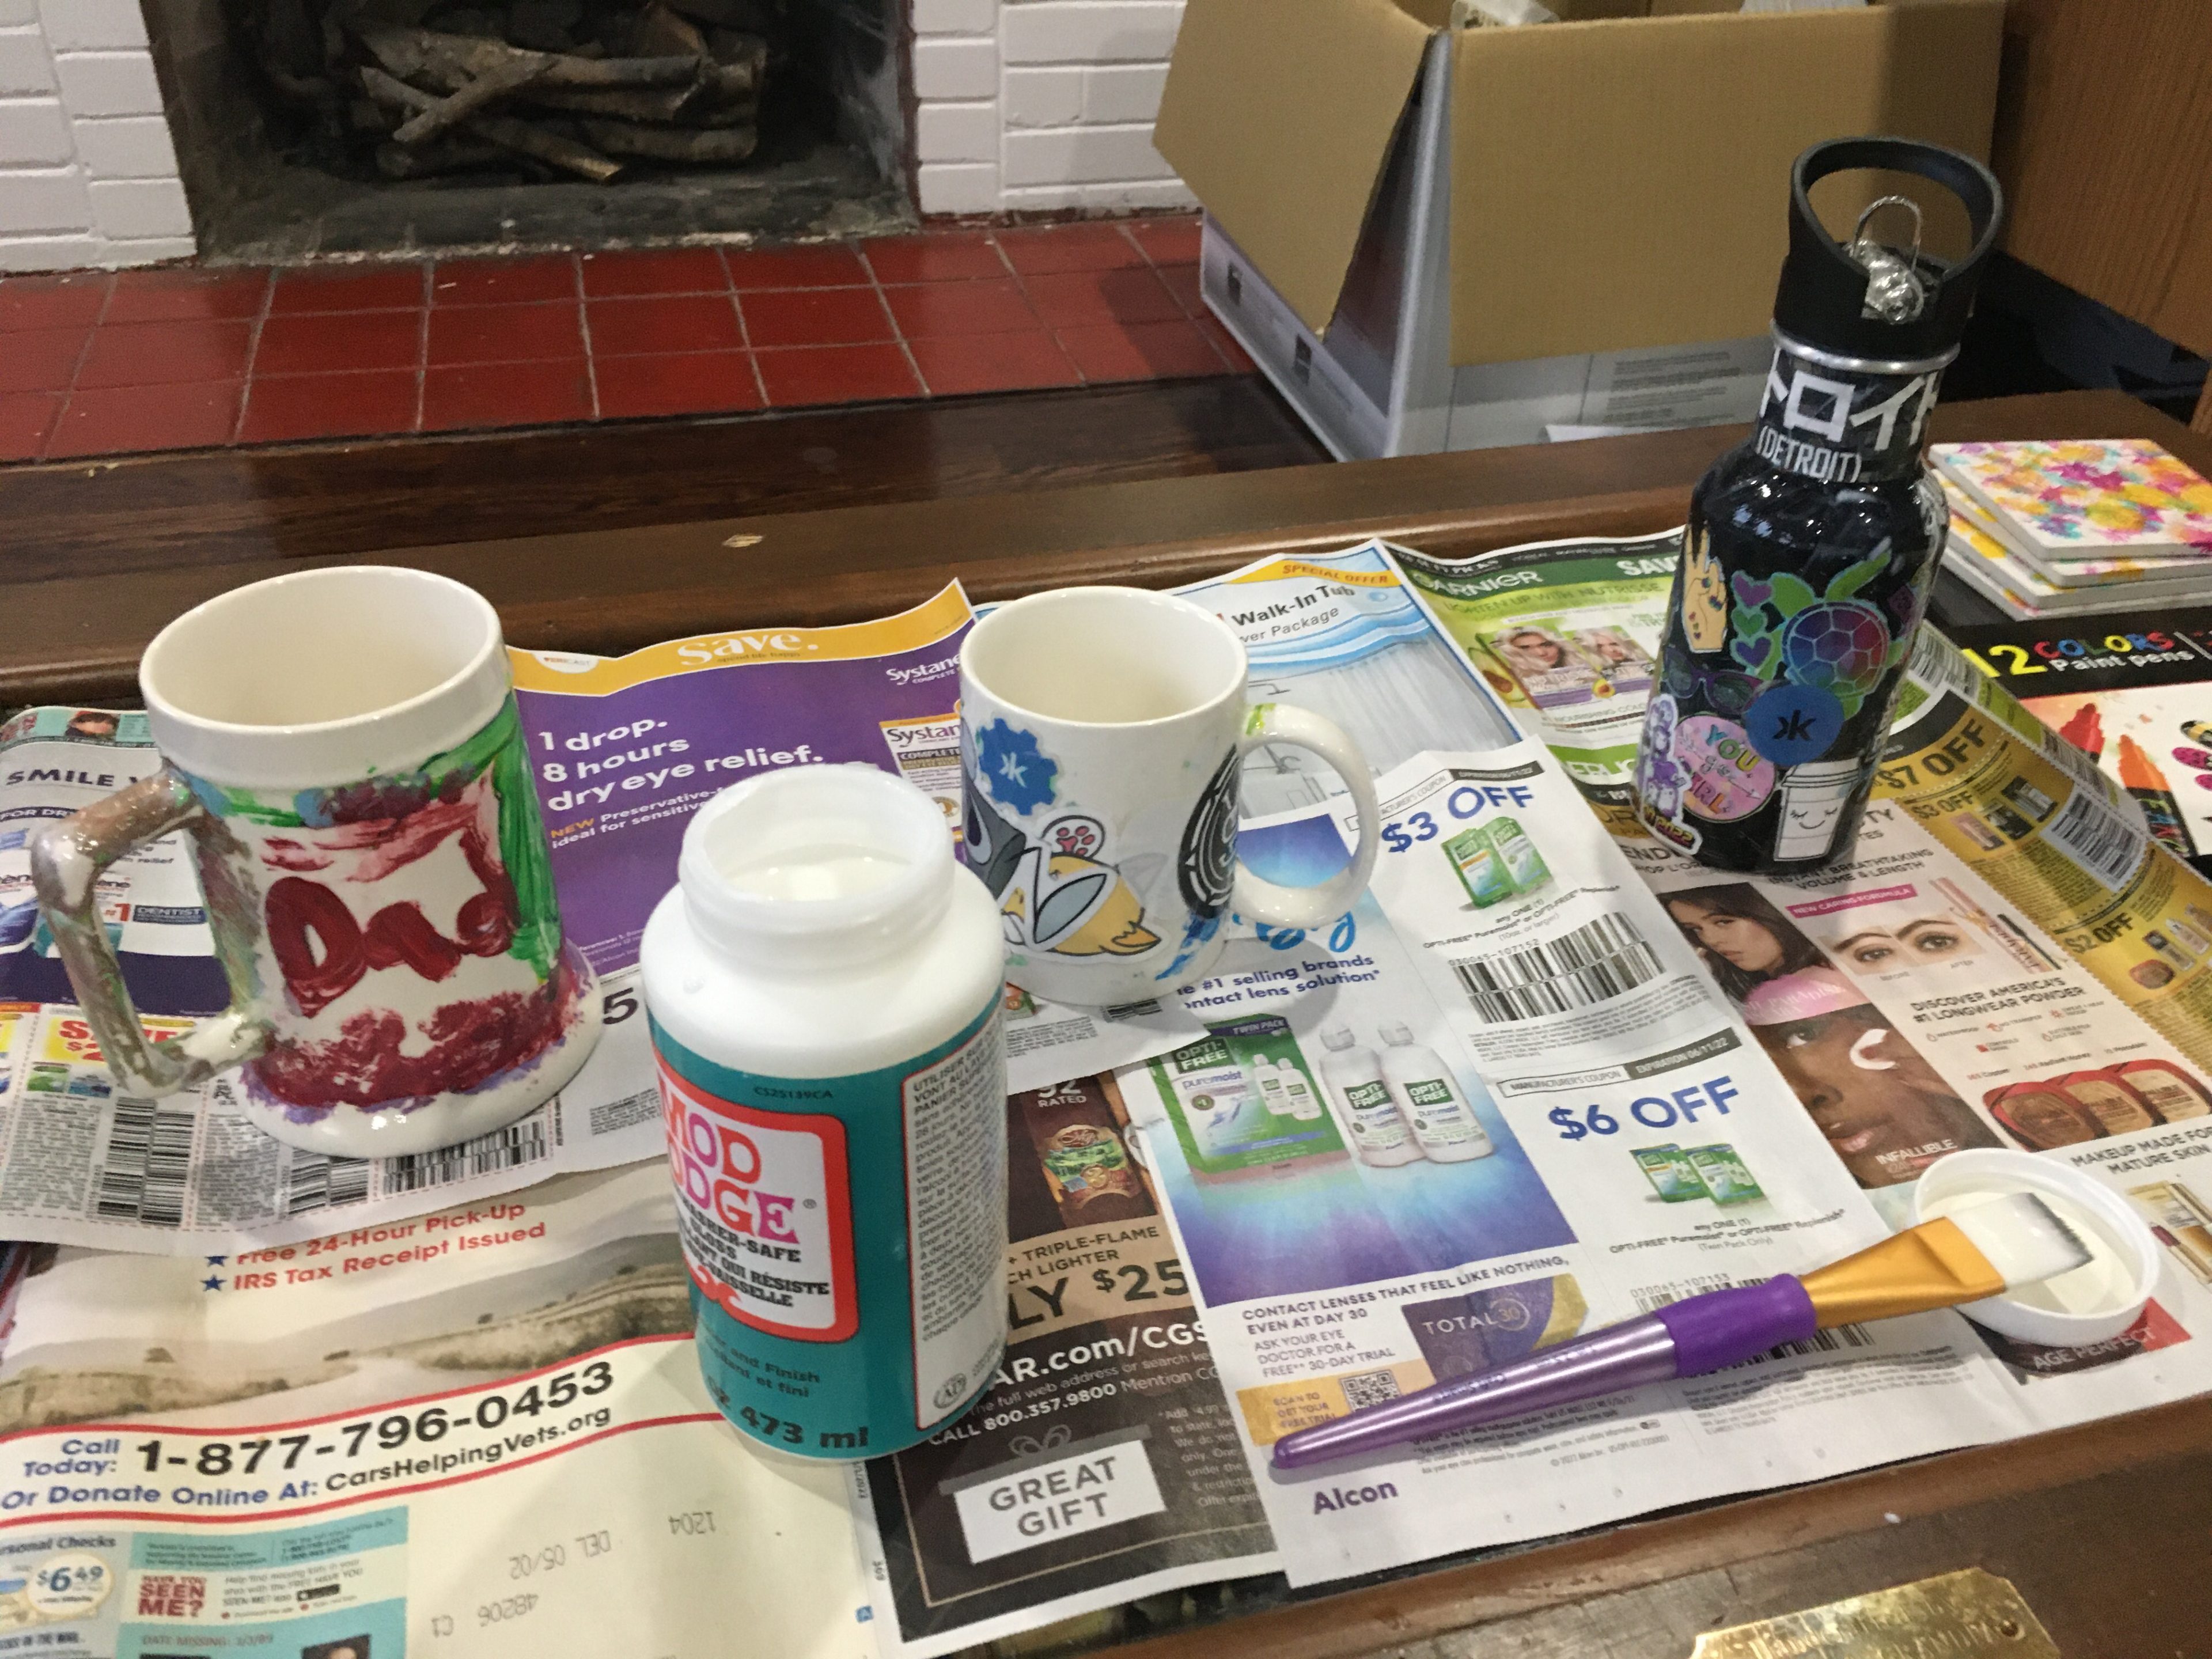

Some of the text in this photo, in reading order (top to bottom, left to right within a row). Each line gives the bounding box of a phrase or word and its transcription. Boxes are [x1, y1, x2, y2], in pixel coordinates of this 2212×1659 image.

[1756, 425, 1862, 483] (DETROIT)
[1282, 563, 1388, 584] SPECIAL OFFER
[1231, 584, 1356, 627] Walk-In Tub
[1578, 582, 1664, 599] NUTRISSE
[1271, 607, 1340, 638] Package
[677, 633, 819, 666] Save.
[1961, 631, 2175, 677] 12 COLORS
[2048, 649, 2195, 672] Paint pens
[539, 718, 668, 751] 1 drop.
[1921, 718, 1986, 776] OFF
[543, 737, 691, 783] 8 hours
[6, 769, 115, 787] SMILE
[547, 744, 824, 812] dry eye relief.
[0, 809, 39, 822] FOR
[1941, 790, 1975, 815] OFF
[550, 817, 596, 839] NEW
[552, 819, 627, 849] ideal for
[1381, 785, 1535, 853] $3 OFF
[1795, 859, 1926, 890] VOLUME LENGTH
[1830, 848, 1934, 874] BREATHTAKING
[2092, 912, 2134, 943] OFF
[1202, 954, 1375, 991] #1 selling brands
[1248, 984, 1290, 999] lens
[1910, 977, 2067, 1012] DISCOVER AMERICA'S
[1912, 1013, 1931, 1024] #1
[1932, 999, 2017, 1022] LONGWEAR
[2020, 986, 2086, 1006] POWDER
[1233, 1020, 1285, 1035] TWIN PACK
[1176, 1040, 1222, 1060] OPTI-
[1181, 1049, 1228, 1070] FREE
[1182, 1070, 1243, 1090] puremoist
[1037, 1095, 1087, 1108] RATED
[1354, 1090, 1387, 1108] FREE
[1414, 1089, 1449, 1104] FREE
[1548, 1075, 1740, 1141] $6 OFF
[657, 1073, 762, 1184] MOD
[1876, 1139, 1958, 1165] INFALLIBLE
[2072, 1134, 2187, 1168] MAKEUP MADE
[2108, 1143, 2211, 1176] MATURE SKIN
[667, 1130, 800, 1245] PODGE
[237, 1202, 527, 1266] Free 24-Hour Pick-Up
[1022, 1226, 1161, 1263] TRIPLE-FLAME
[233, 1222, 546, 1291] IRS Tax Receipt Issued
[1037, 1249, 1120, 1278] LIGHTER
[749, 1268, 830, 1296] RÉSISTE
[1243, 1255, 1571, 1320] CONTACT LENSES THAT FEEL LIKE NOTHING,
[1247, 1307, 1369, 1336] EVEN AT DAY 30
[1422, 1307, 1521, 1336] TOTAL 30
[1254, 1329, 1345, 1353] ASK YOUR EYE
[1257, 1340, 1358, 1366] DOCTOR FOR A
[2032, 1326, 2156, 1370] AGE PERFECT
[1308, 1354, 1358, 1371] 30-DAY
[1358, 1347, 1396, 1363] TRIAL
[997, 1354, 1190, 1407] full web address or search
[61, 1361, 614, 1476] Call 1-877-796-0453
[927, 1371, 1192, 1446] CALL 800.357.9800 Mention
[740, 1406, 869, 1449] 473 ml
[1, 1406, 612, 1510] Or Donate Online At: CarsHelpingVets.org
[24, 1459, 118, 1478] Today:
[1185, 1465, 1220, 1477] under
[988, 1456, 1118, 1512] GREAT
[1313, 1482, 1399, 1516] Alcon
[668, 1512, 717, 1536] 1204
[1017, 1492, 1109, 1538] GIFT
[56, 1536, 116, 1548] Checks
[509, 1529, 611, 1580] DEL 05/02
[139, 1582, 206, 1599] SEEN
[138, 1599, 203, 1618] ME?
[478, 1593, 540, 1628] 48206
